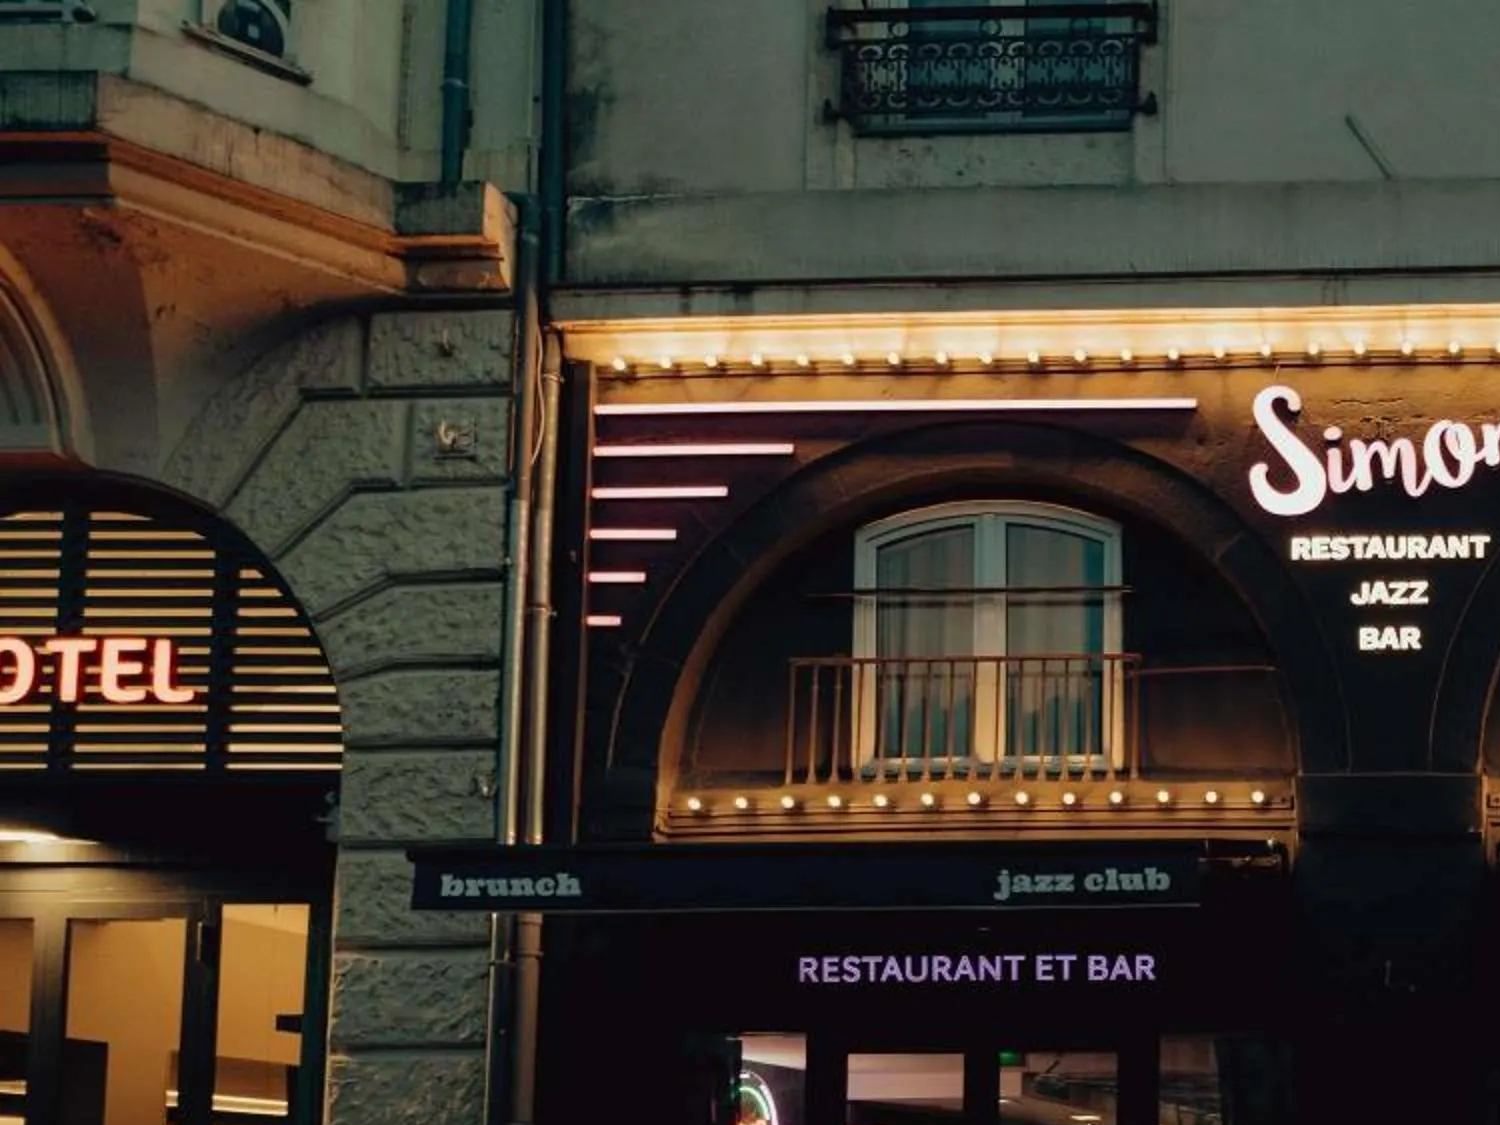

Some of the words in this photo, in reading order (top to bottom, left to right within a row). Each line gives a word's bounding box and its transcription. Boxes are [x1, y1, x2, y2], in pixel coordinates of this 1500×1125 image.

[1290, 534, 1491, 561] RESTAURANT
[1350, 580, 1429, 606] JAZZ
[1358, 626, 1422, 651] BAR
[440, 872, 582, 897] brunch
[993, 868, 1075, 901] jazz
[1083, 867, 1171, 893] club
[799, 955, 1025, 983] RESTAURANT
[1035, 954, 1078, 981] ET
[1087, 954, 1156, 982] BAR
